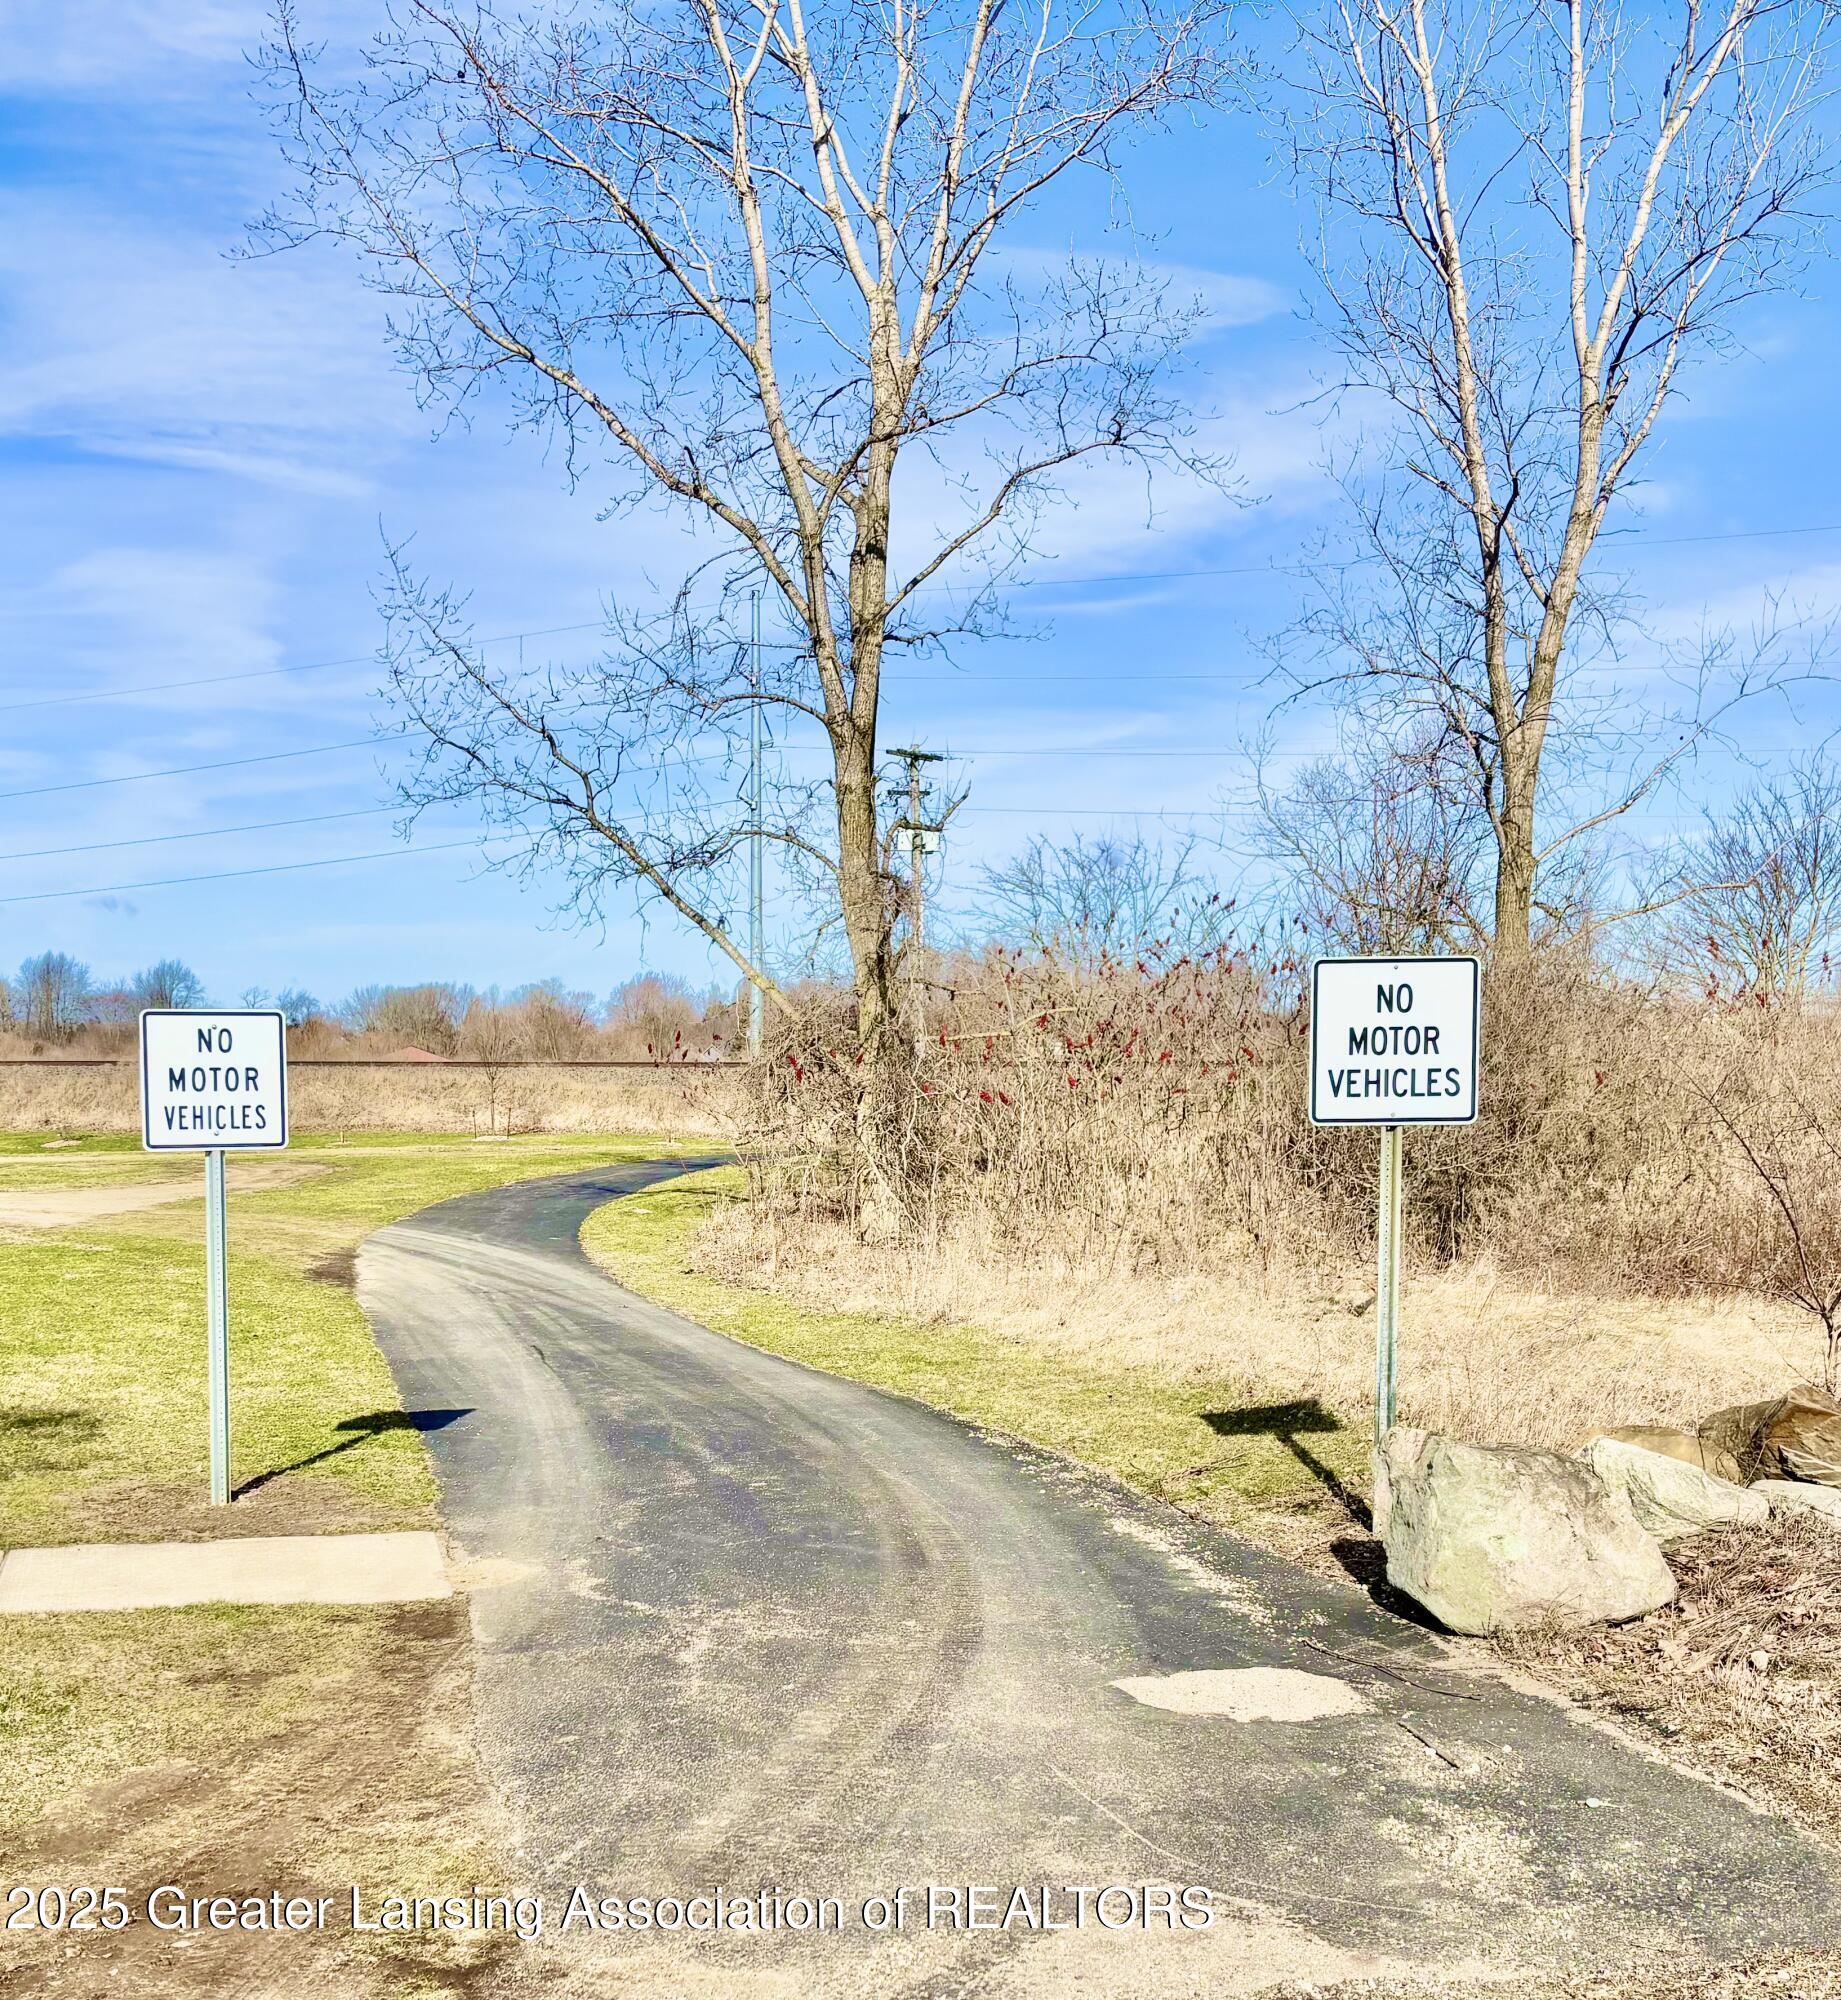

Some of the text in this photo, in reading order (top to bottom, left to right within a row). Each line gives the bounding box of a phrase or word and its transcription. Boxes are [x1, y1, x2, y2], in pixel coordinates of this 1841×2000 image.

[1376, 983, 1414, 1014] NO
[197, 1027, 233, 1054] NO
[1347, 1025, 1440, 1056] MOTOR
[168, 1066, 260, 1093] MOTOR
[1327, 1067, 1461, 1098] VEHICLES
[164, 1104, 267, 1131] VEHICLES
